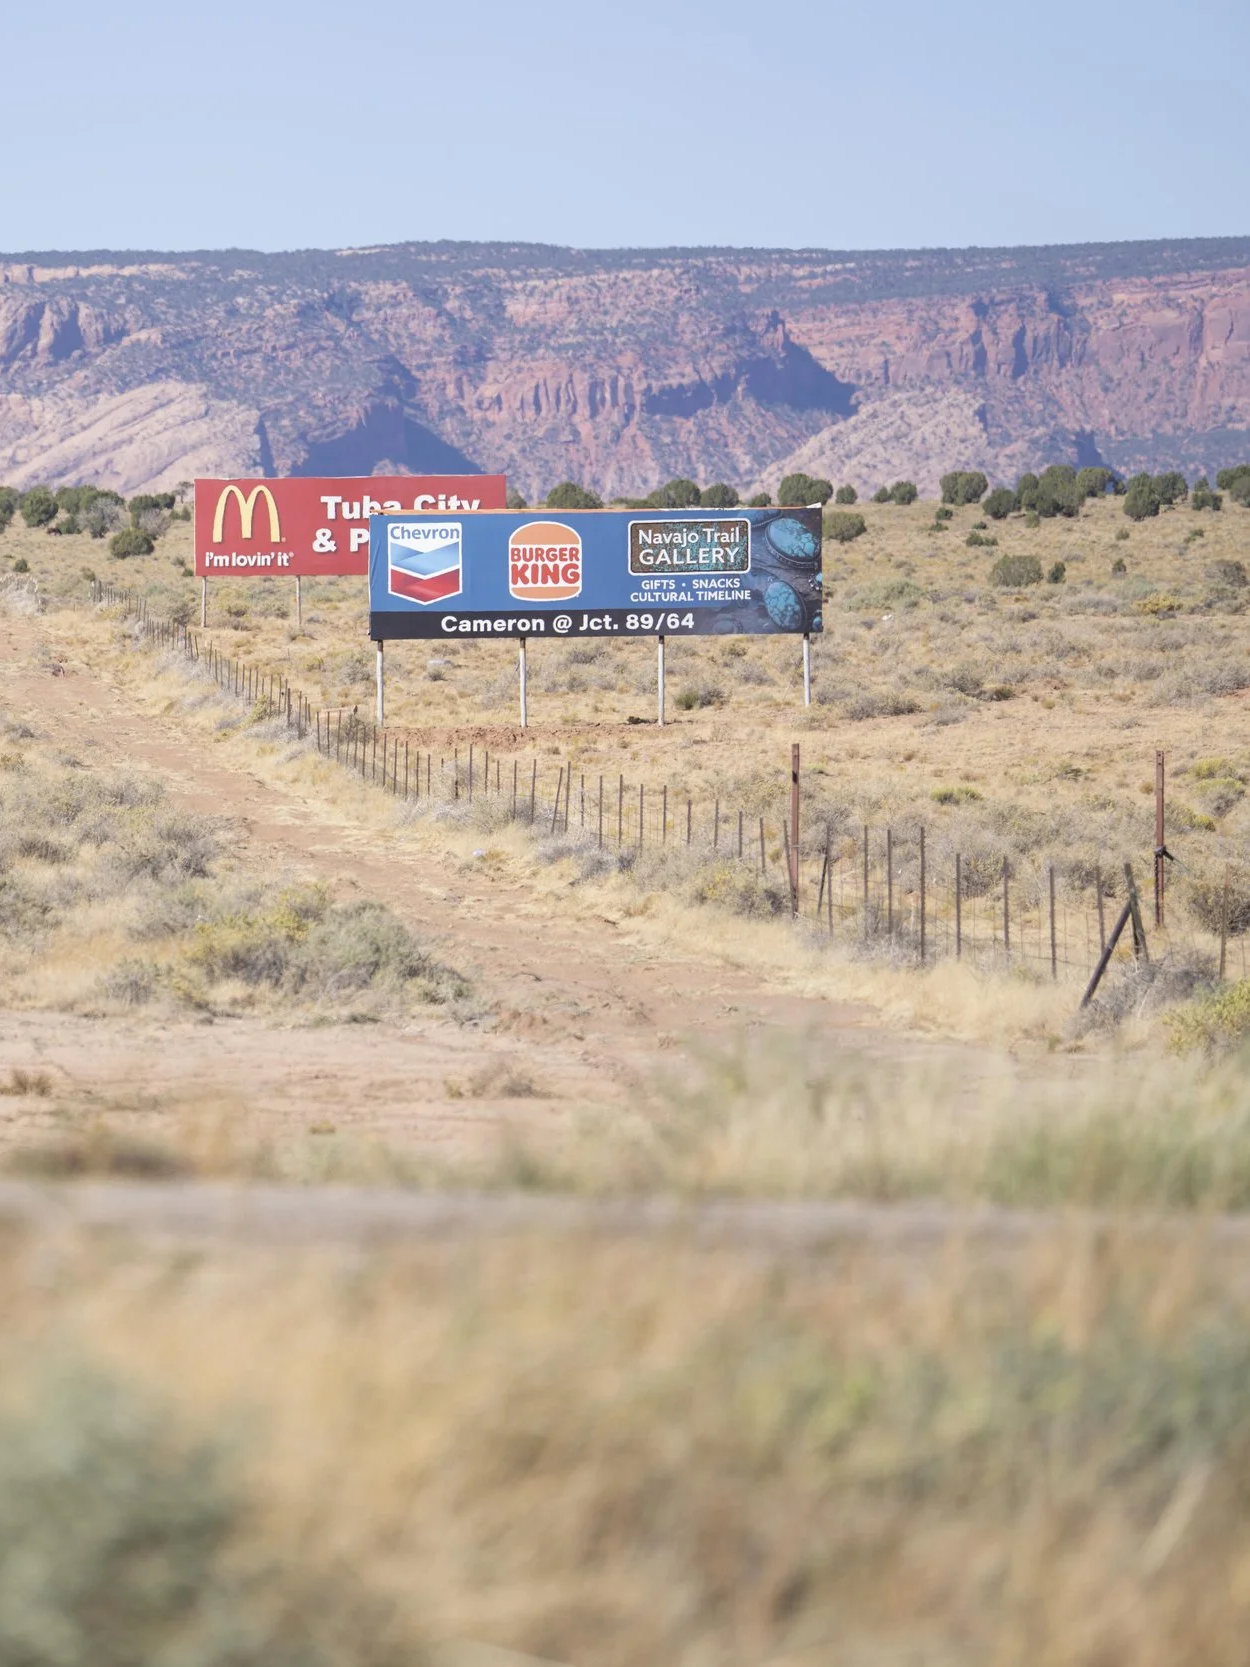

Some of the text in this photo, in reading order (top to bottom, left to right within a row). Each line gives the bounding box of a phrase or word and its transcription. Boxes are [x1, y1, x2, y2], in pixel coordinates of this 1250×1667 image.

[312, 528, 337, 553] &
[390, 526, 460, 540] Chevron
[638, 527, 740, 547] Navajo Trail
[511, 547, 580, 562] BURGER
[639, 547, 740, 565] GALLERY
[511, 563, 580, 585] KING
[641, 578, 741, 590] GIFTS SNACKS
[630, 590, 752, 602] CULTURAL TIMELINE
[441, 613, 695, 633] Cameron @ Jct. 89/64
